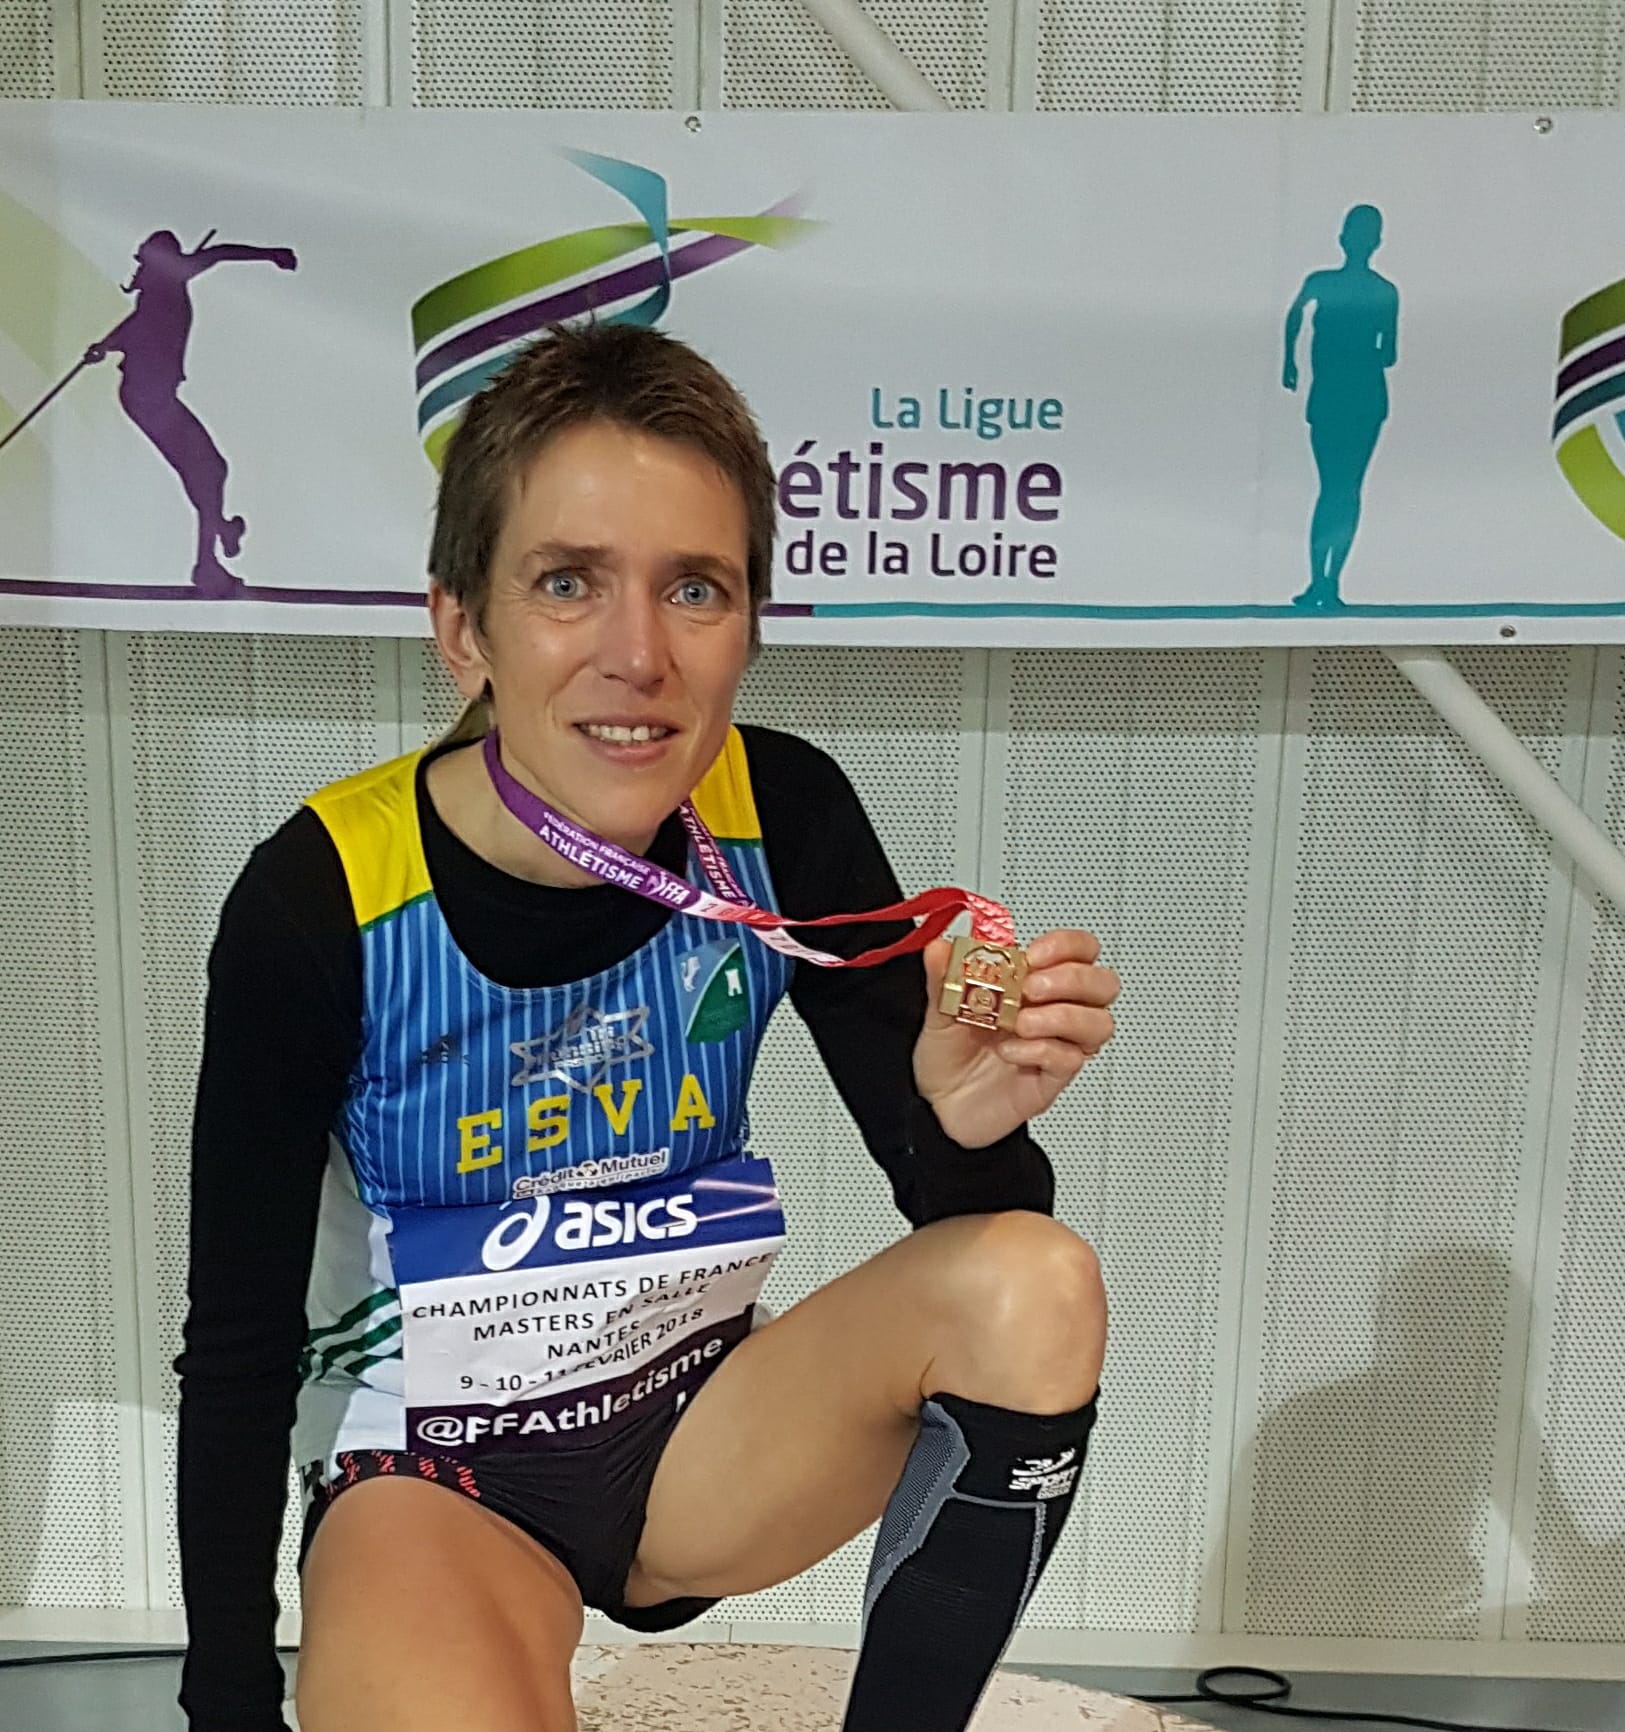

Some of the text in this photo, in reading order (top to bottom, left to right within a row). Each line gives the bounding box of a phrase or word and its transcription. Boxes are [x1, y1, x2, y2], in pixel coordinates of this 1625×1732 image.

[871, 387, 1063, 440] La Ligue
[765, 440, 1063, 522] étisme
[785, 530, 1058, 578] de la Loire
[539, 825, 644, 889] ATHLÉTISME
[456, 1073, 716, 1174] ESVA
[515, 1151, 667, 1192] Crédit Mutuel
[412, 1252, 774, 1319] CHAMPIONNATS DE FRANCE
[460, 1375, 474, 1390] 9
[495, 1375, 522, 1392] 10
[656, 1308, 705, 1341] 2018
[473, 1313, 595, 1342] MASTERS
[605, 1303, 634, 1325] EN
[547, 1320, 642, 1360] NANTES
[416, 1337, 724, 1447] @FFAthletisme
